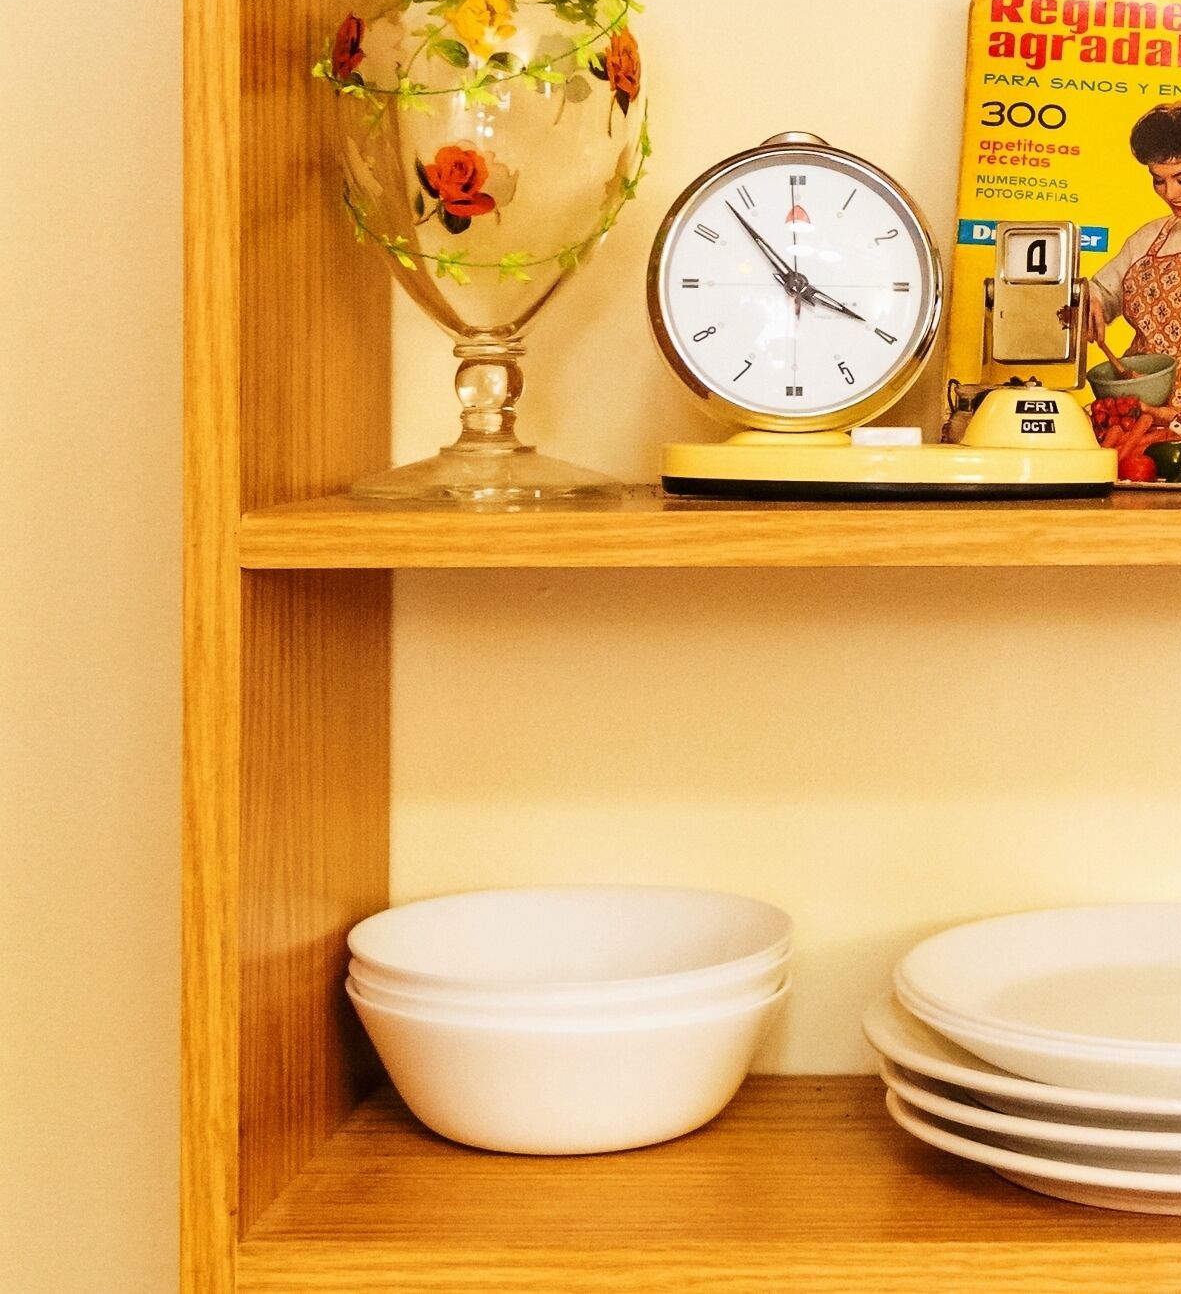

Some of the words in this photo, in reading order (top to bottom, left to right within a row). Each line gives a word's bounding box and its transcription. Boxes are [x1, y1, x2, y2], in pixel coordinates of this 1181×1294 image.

[983, 73, 1040, 88] PARA
[1050, 77, 1129, 94] SANOS
[1138, 83, 1150, 95] Y
[980, 101, 1068, 130] 300
[979, 138, 1081, 157] apetitosas
[977, 153, 1051, 168] recetas
[976, 174, 1069, 189] NUMEROSAS
[975, 188, 1080, 203] FOTOGRAFIAS
[874, 228, 899, 246] 2
[692, 326, 717, 343] 8
[874, 327, 898, 345] 4
[732, 359, 753, 382] 7
[837, 361, 855, 385] 5
[1024, 401, 1054, 413] FRI
[1022, 421, 1047, 432] OCT
